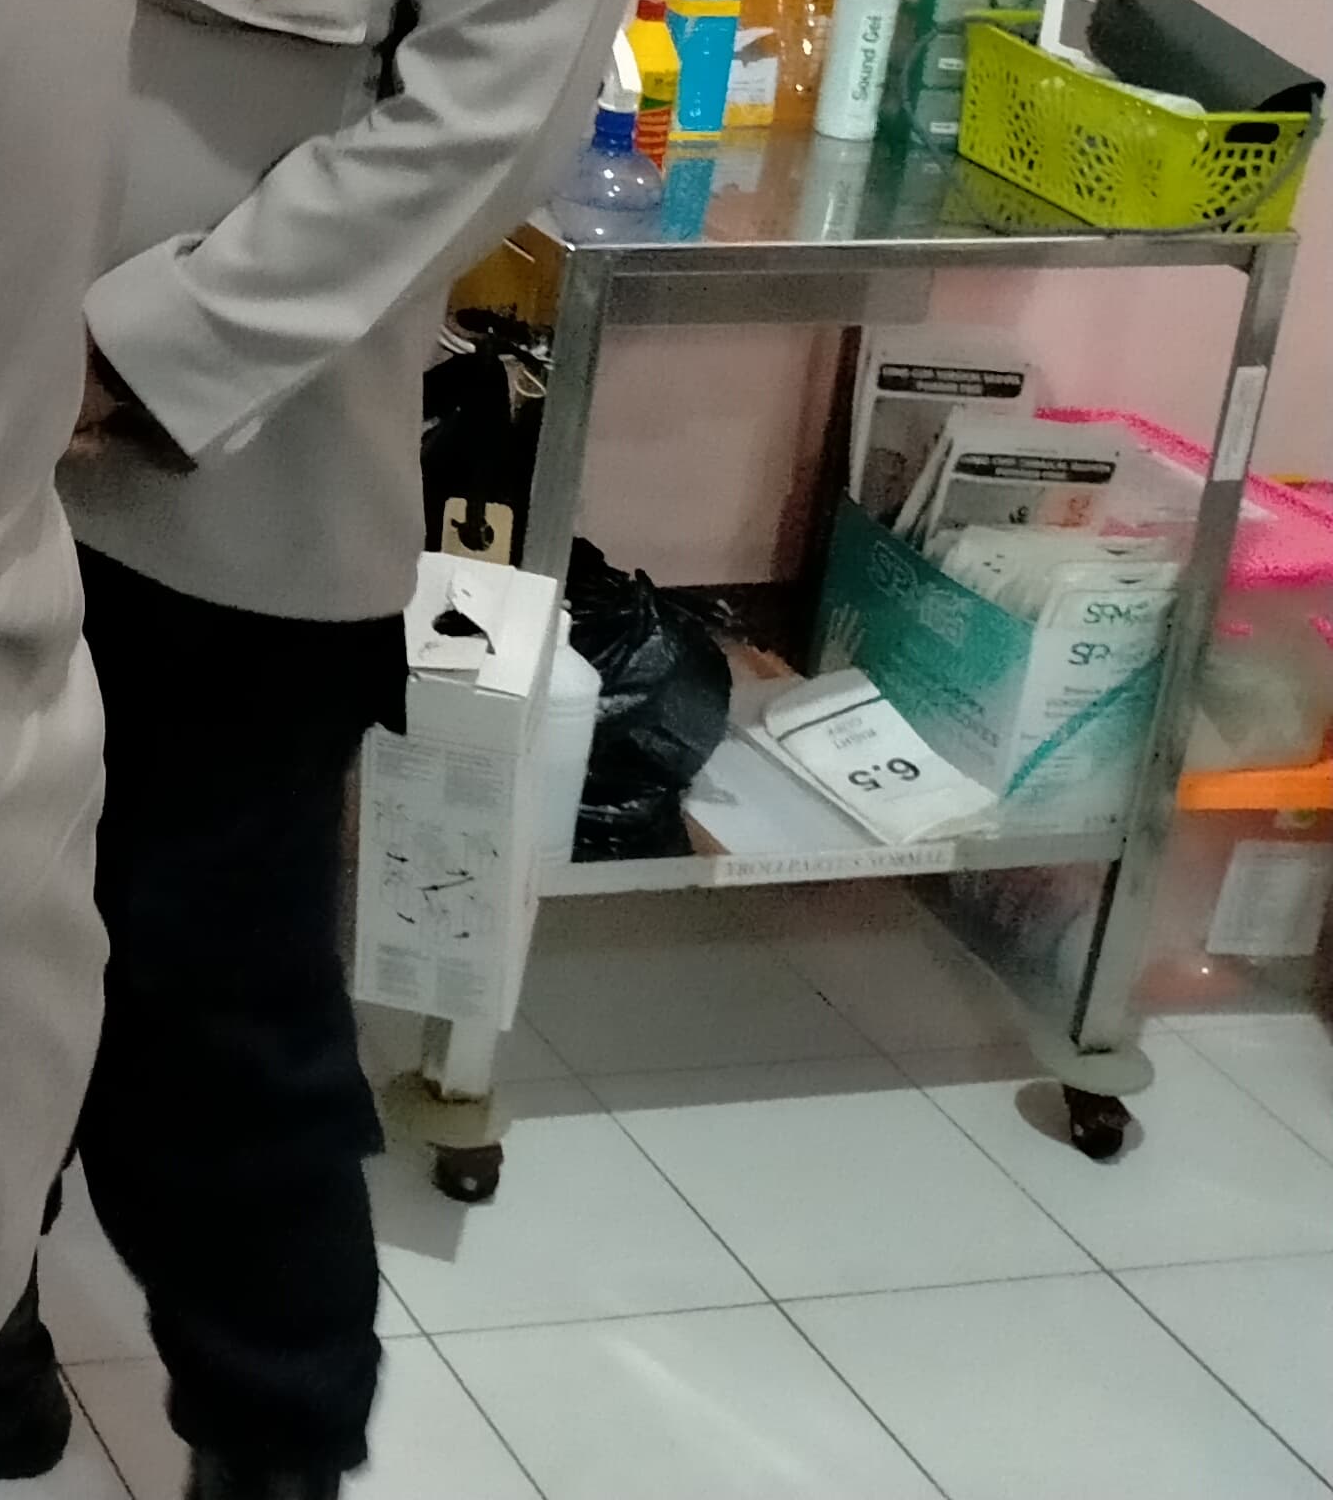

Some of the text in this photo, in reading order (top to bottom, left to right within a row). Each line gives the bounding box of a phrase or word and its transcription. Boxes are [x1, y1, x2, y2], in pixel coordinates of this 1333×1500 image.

[852, 15, 883, 101] Sound Gel
[848, 757, 921, 792] 6.5
